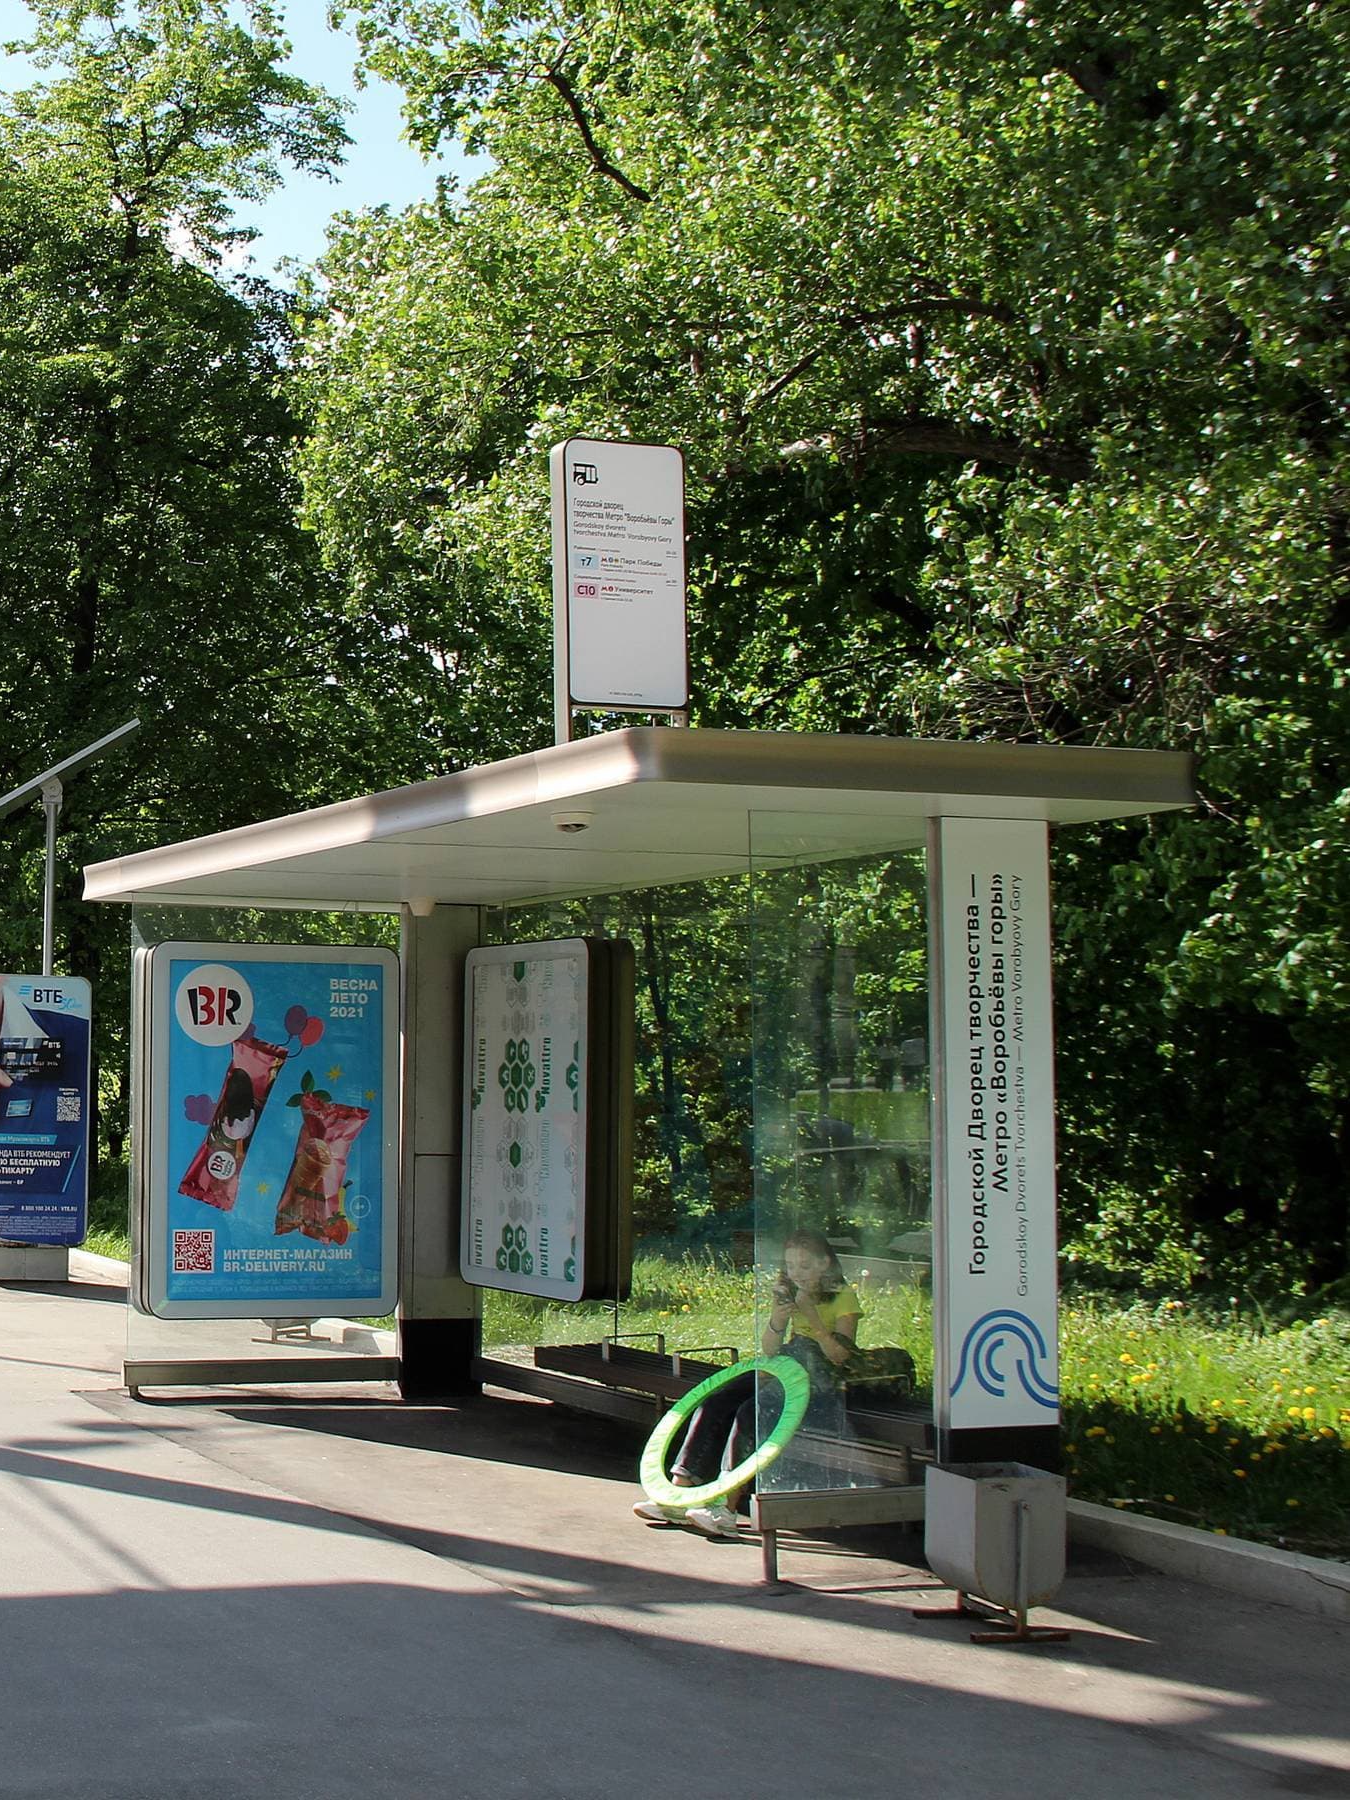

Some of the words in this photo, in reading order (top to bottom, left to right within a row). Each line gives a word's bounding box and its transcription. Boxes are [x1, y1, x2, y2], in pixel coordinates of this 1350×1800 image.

[620, 557, 636, 567] Парк
[991, 873, 1007, 945] горы»
[1009, 874, 1024, 911] Gory
[967, 904, 985, 1040] творчества
[1009, 915, 1025, 992] Vorobyovy
[33, 989, 63, 1004] ВТБ
[187, 986, 242, 1026] BR
[329, 978, 379, 991] ВЕСНА
[329, 992, 369, 1004] ЛЕТО
[329, 1006, 365, 1019] 2021
[988, 952, 1010, 1104] «Воробьёвы
[1011, 996, 1024, 1042] Metro
[967, 1045, 987, 1141] Дворец
[1013, 1066, 1027, 1152] Tvorchestva
[9, 1158, 61, 1167] БЕСПЛАТНУЮ
[26, 1150, 71, 1159] РЕКОМЕНДУЕТ
[991, 1110, 1011, 1193] Метро
[1015, 1156, 1027, 1213] Dvorets
[968, 1148, 989, 1275] Городской
[222, 1260, 326, 1273] BR-DELIVERY.RU
[223, 1248, 353, 1260] ИНТЕРНЕТ-МАГАЗИН
[1015, 1217, 1030, 1297] Gorodskoy
